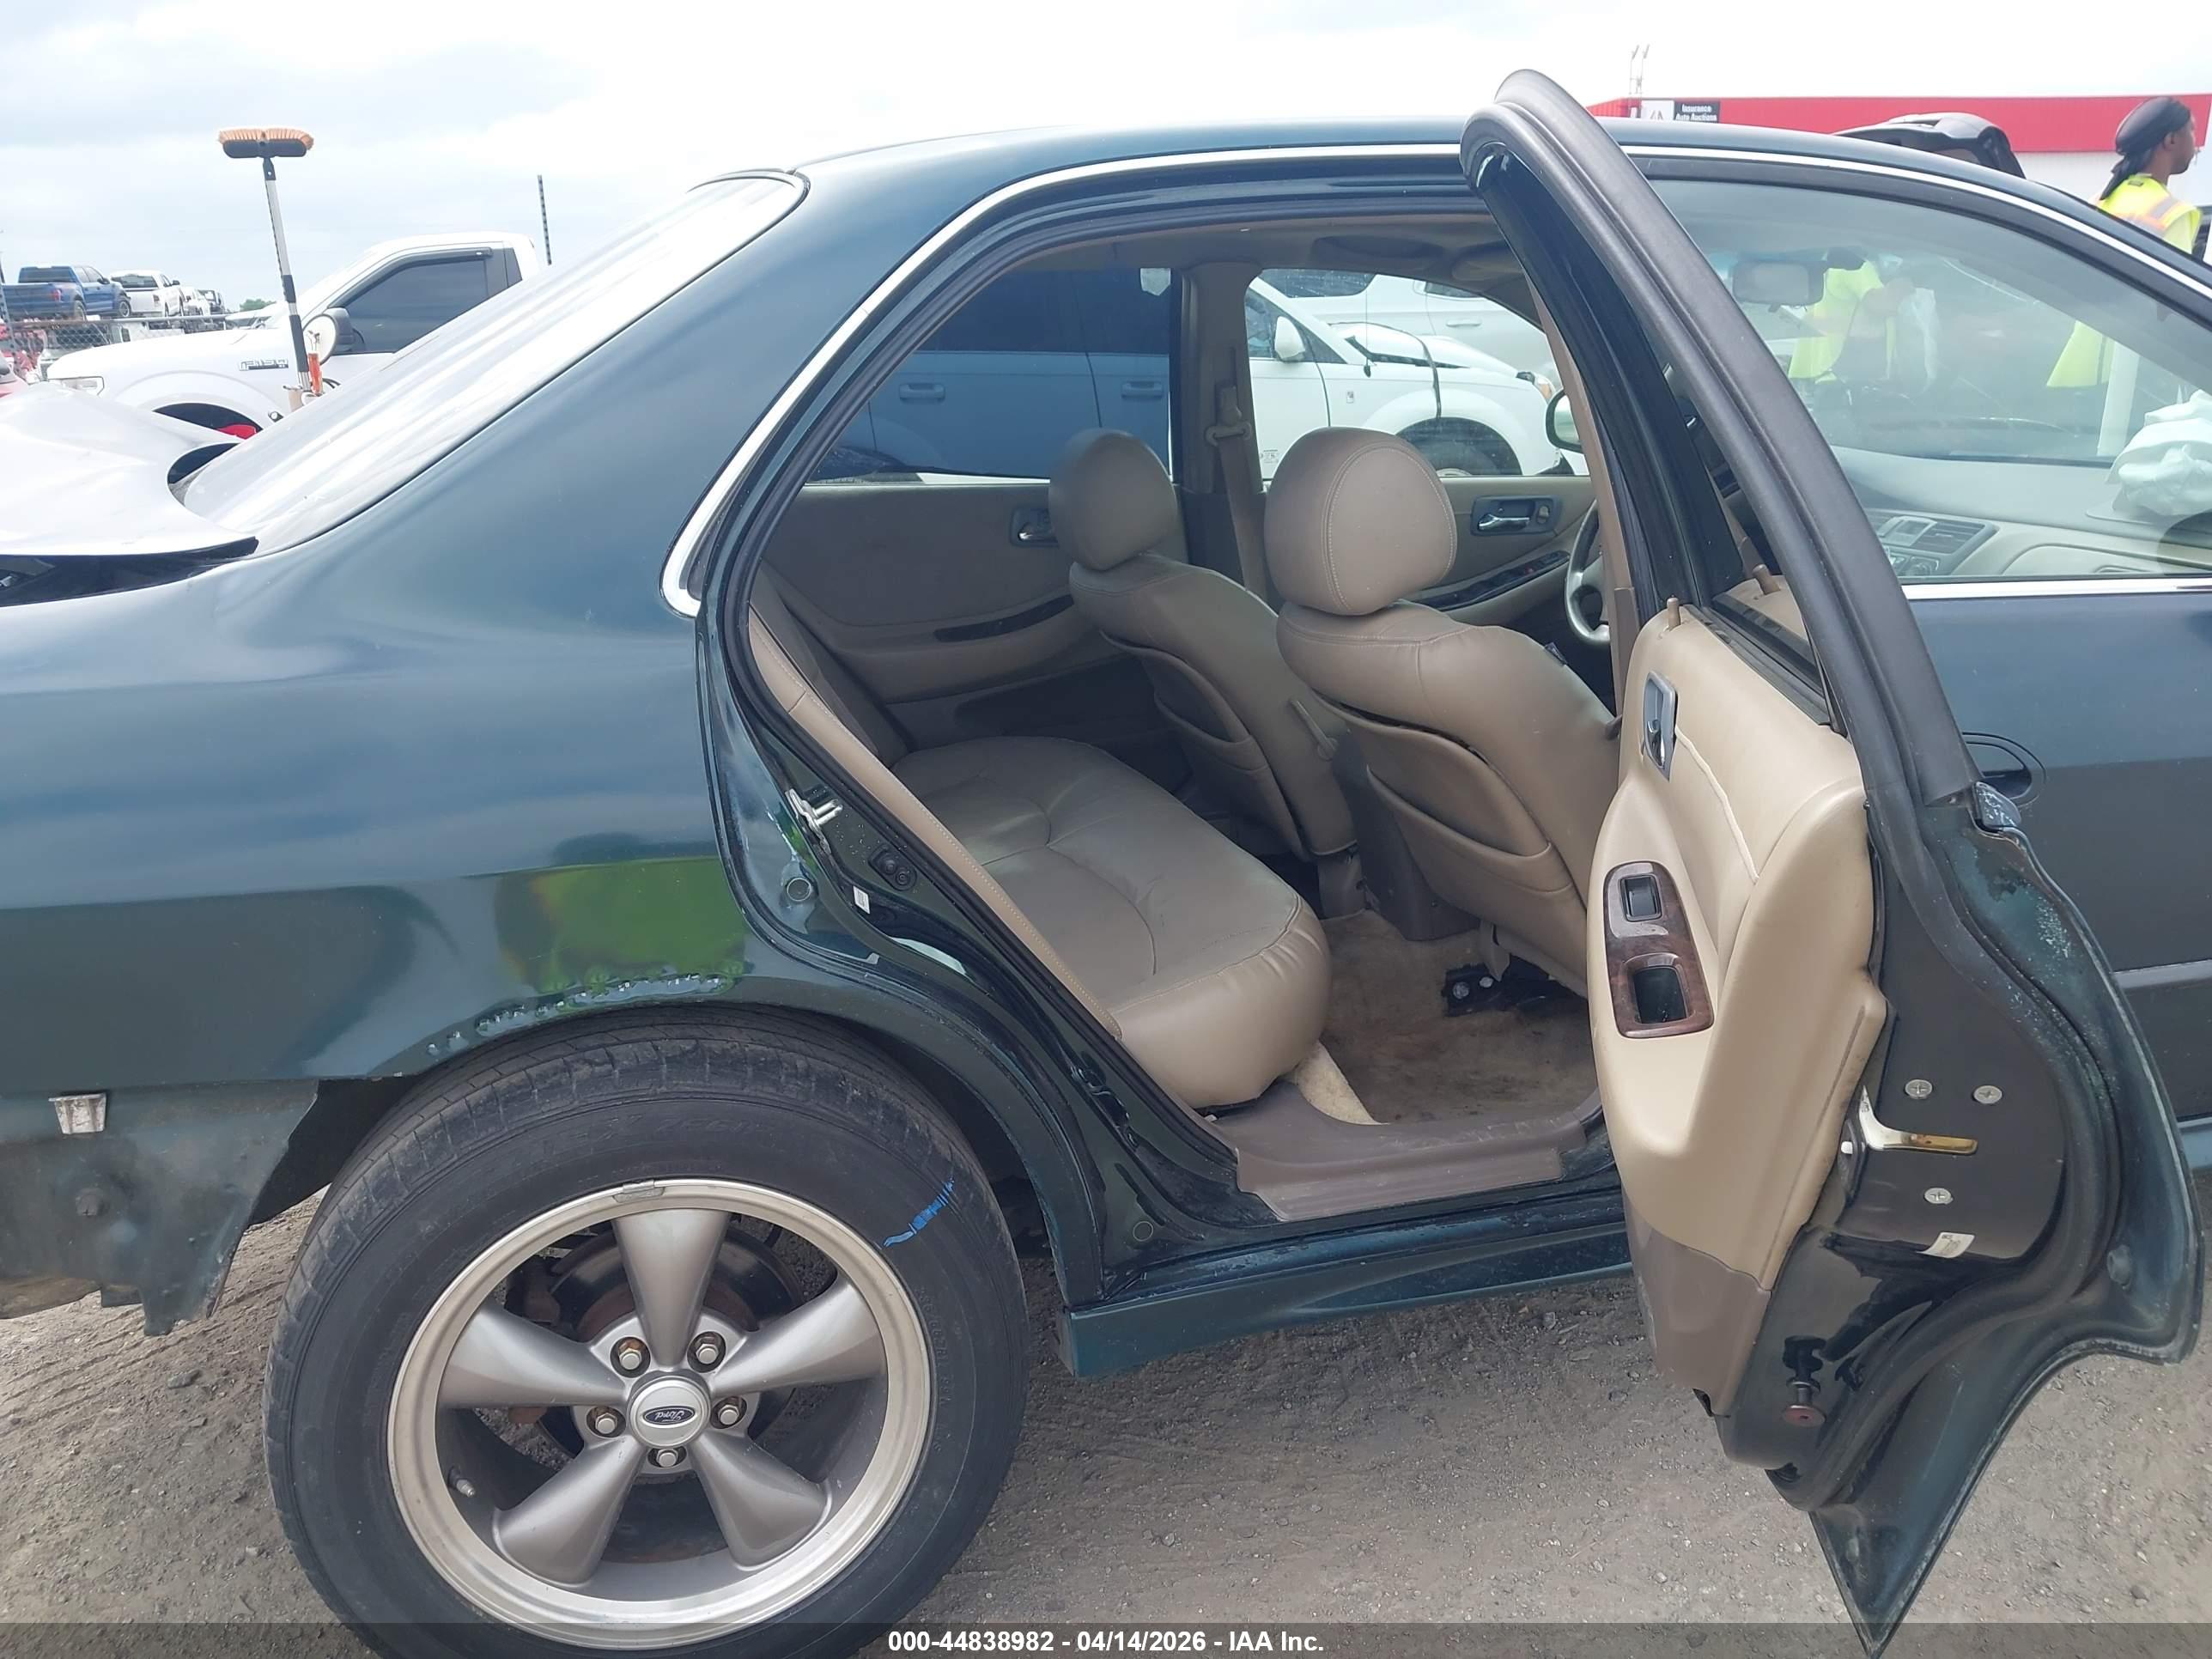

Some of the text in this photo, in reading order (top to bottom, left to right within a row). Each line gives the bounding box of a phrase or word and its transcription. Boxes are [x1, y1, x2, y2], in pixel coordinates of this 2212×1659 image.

[1681, 104, 1712, 112] Insurance
[1690, 113, 1717, 122] Auctions
[654, 1410, 685, 1422] Ford
